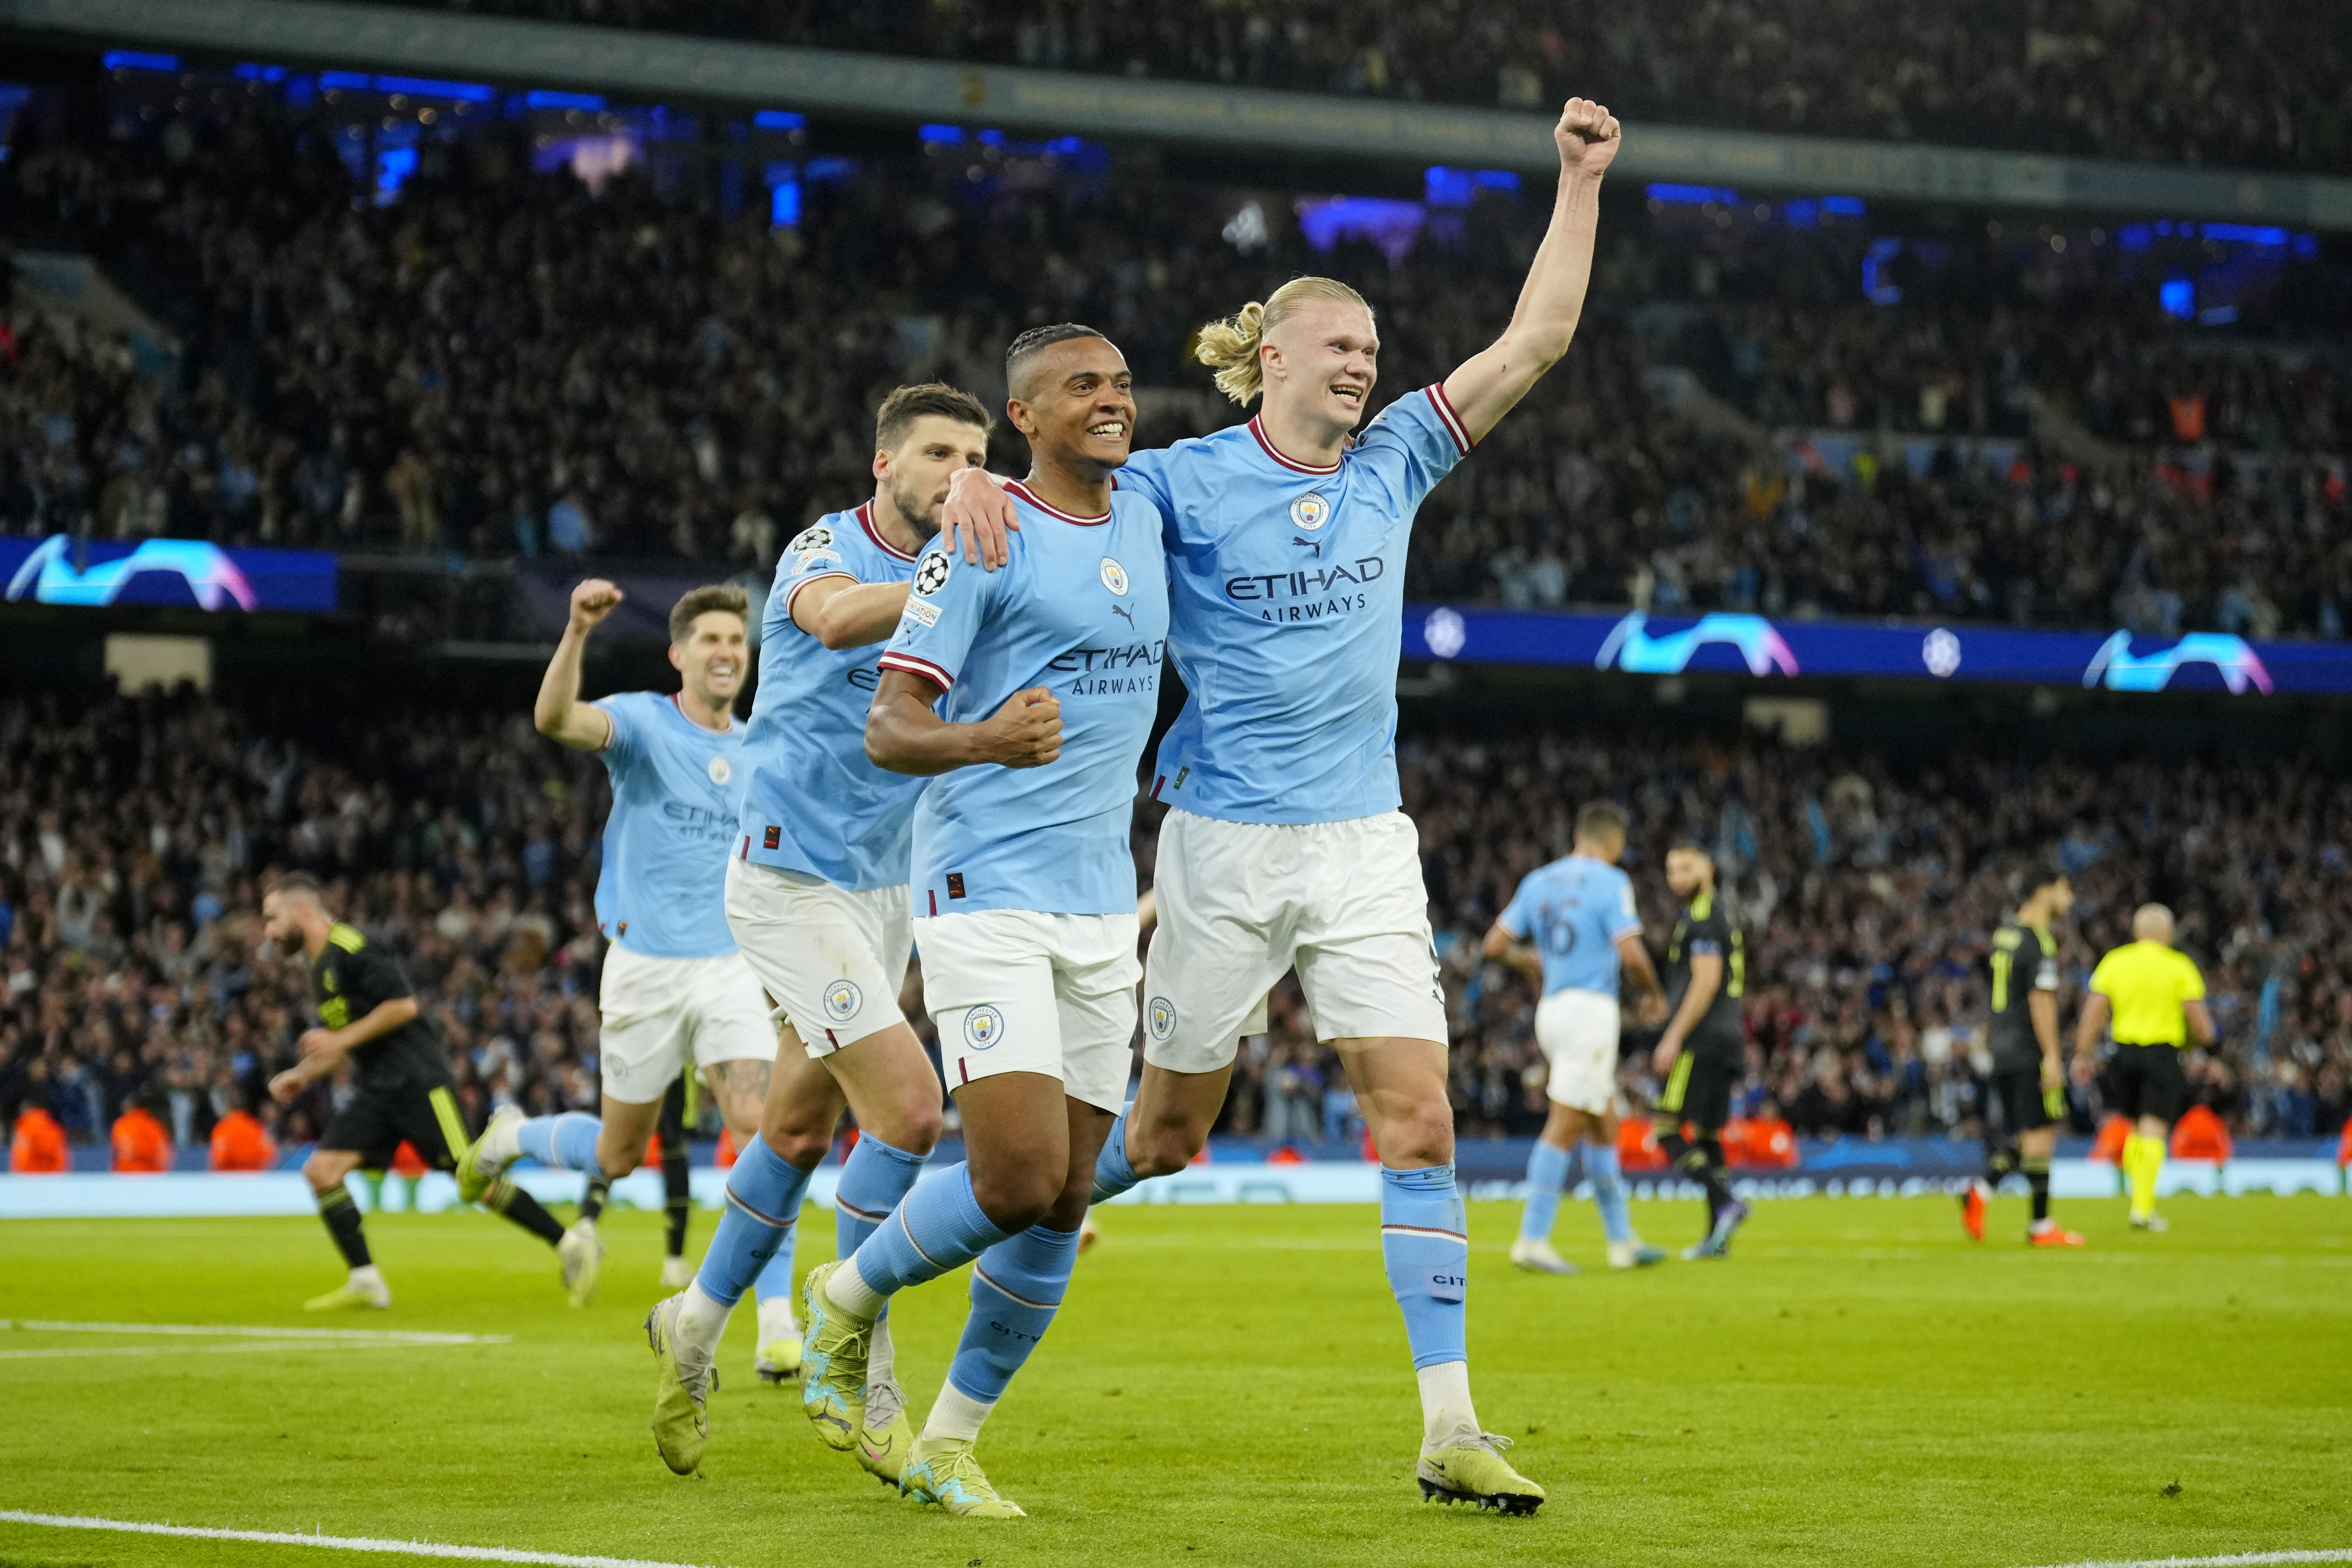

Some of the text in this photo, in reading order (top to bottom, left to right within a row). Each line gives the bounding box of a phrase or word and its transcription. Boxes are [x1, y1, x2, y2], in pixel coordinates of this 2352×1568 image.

[1294, 494, 1326, 508] MANCHESTER
[1101, 559, 1121, 571] MANCHESTER
[1226, 557, 1384, 600] ETIHAD
[1261, 594, 1365, 622] AIRWAYS
[1047, 640, 1164, 671] ETIHAD
[1072, 676, 1152, 694] AIRWAYS
[826, 983, 854, 1003] MANCHESTER
[843, 1011, 853, 1019] CITY
[967, 1008, 997, 1026] MANCHESTER
[1152, 1001, 1173, 1017] MANCHESTER
[1433, 1275, 1466, 1287] CIT
